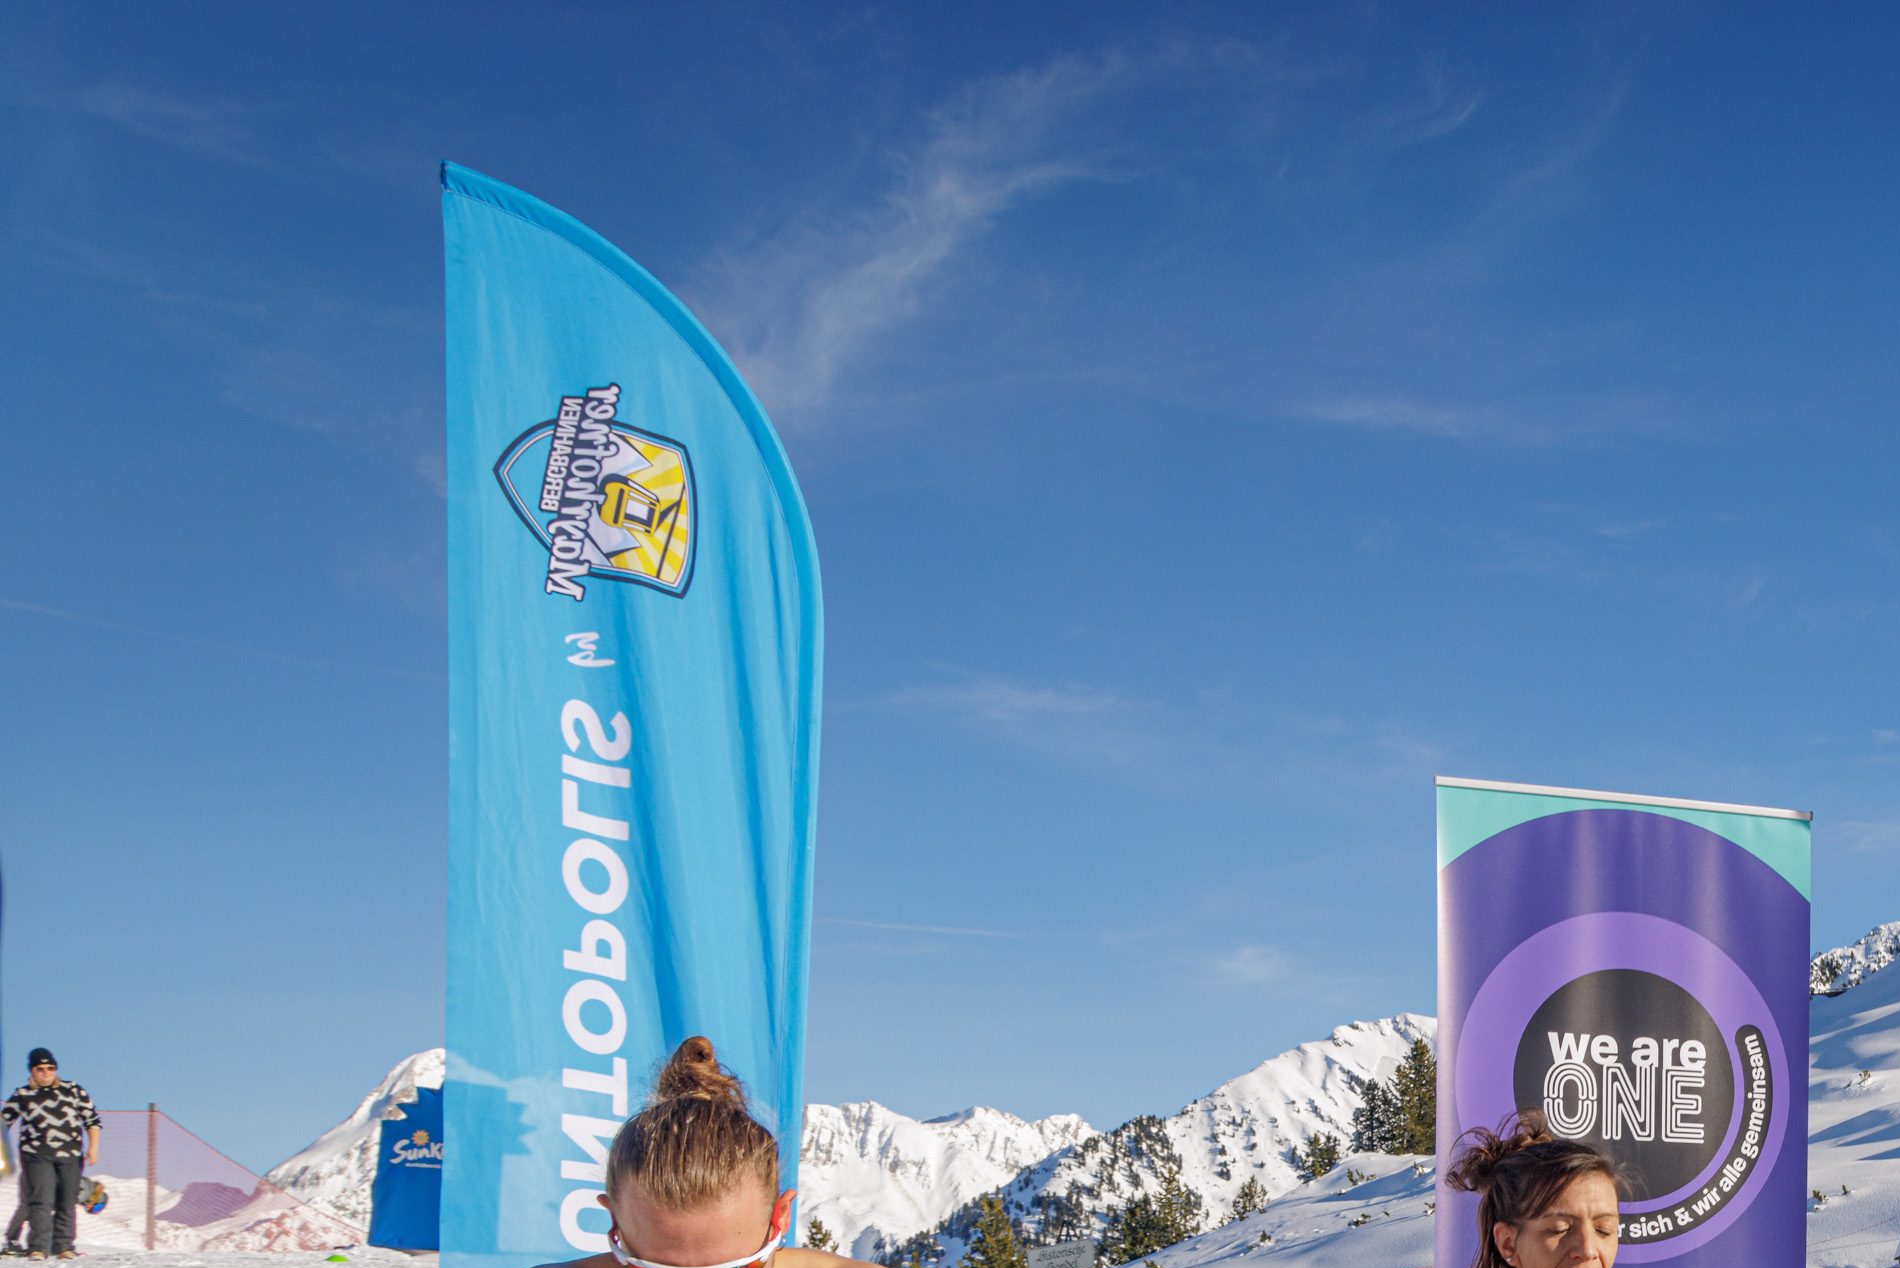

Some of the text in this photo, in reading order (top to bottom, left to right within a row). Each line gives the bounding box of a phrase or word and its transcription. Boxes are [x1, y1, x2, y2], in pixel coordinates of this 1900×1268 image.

[1548, 1031, 1706, 1069] we are
[1543, 1059, 1705, 1144] ONE
[1629, 1214, 1674, 1238] sich
[1674, 1207, 1694, 1226] &
[1691, 1188, 1721, 1216] wir
[1719, 1157, 1746, 1192] alle
[1741, 1034, 1766, 1159] gemeinsam
